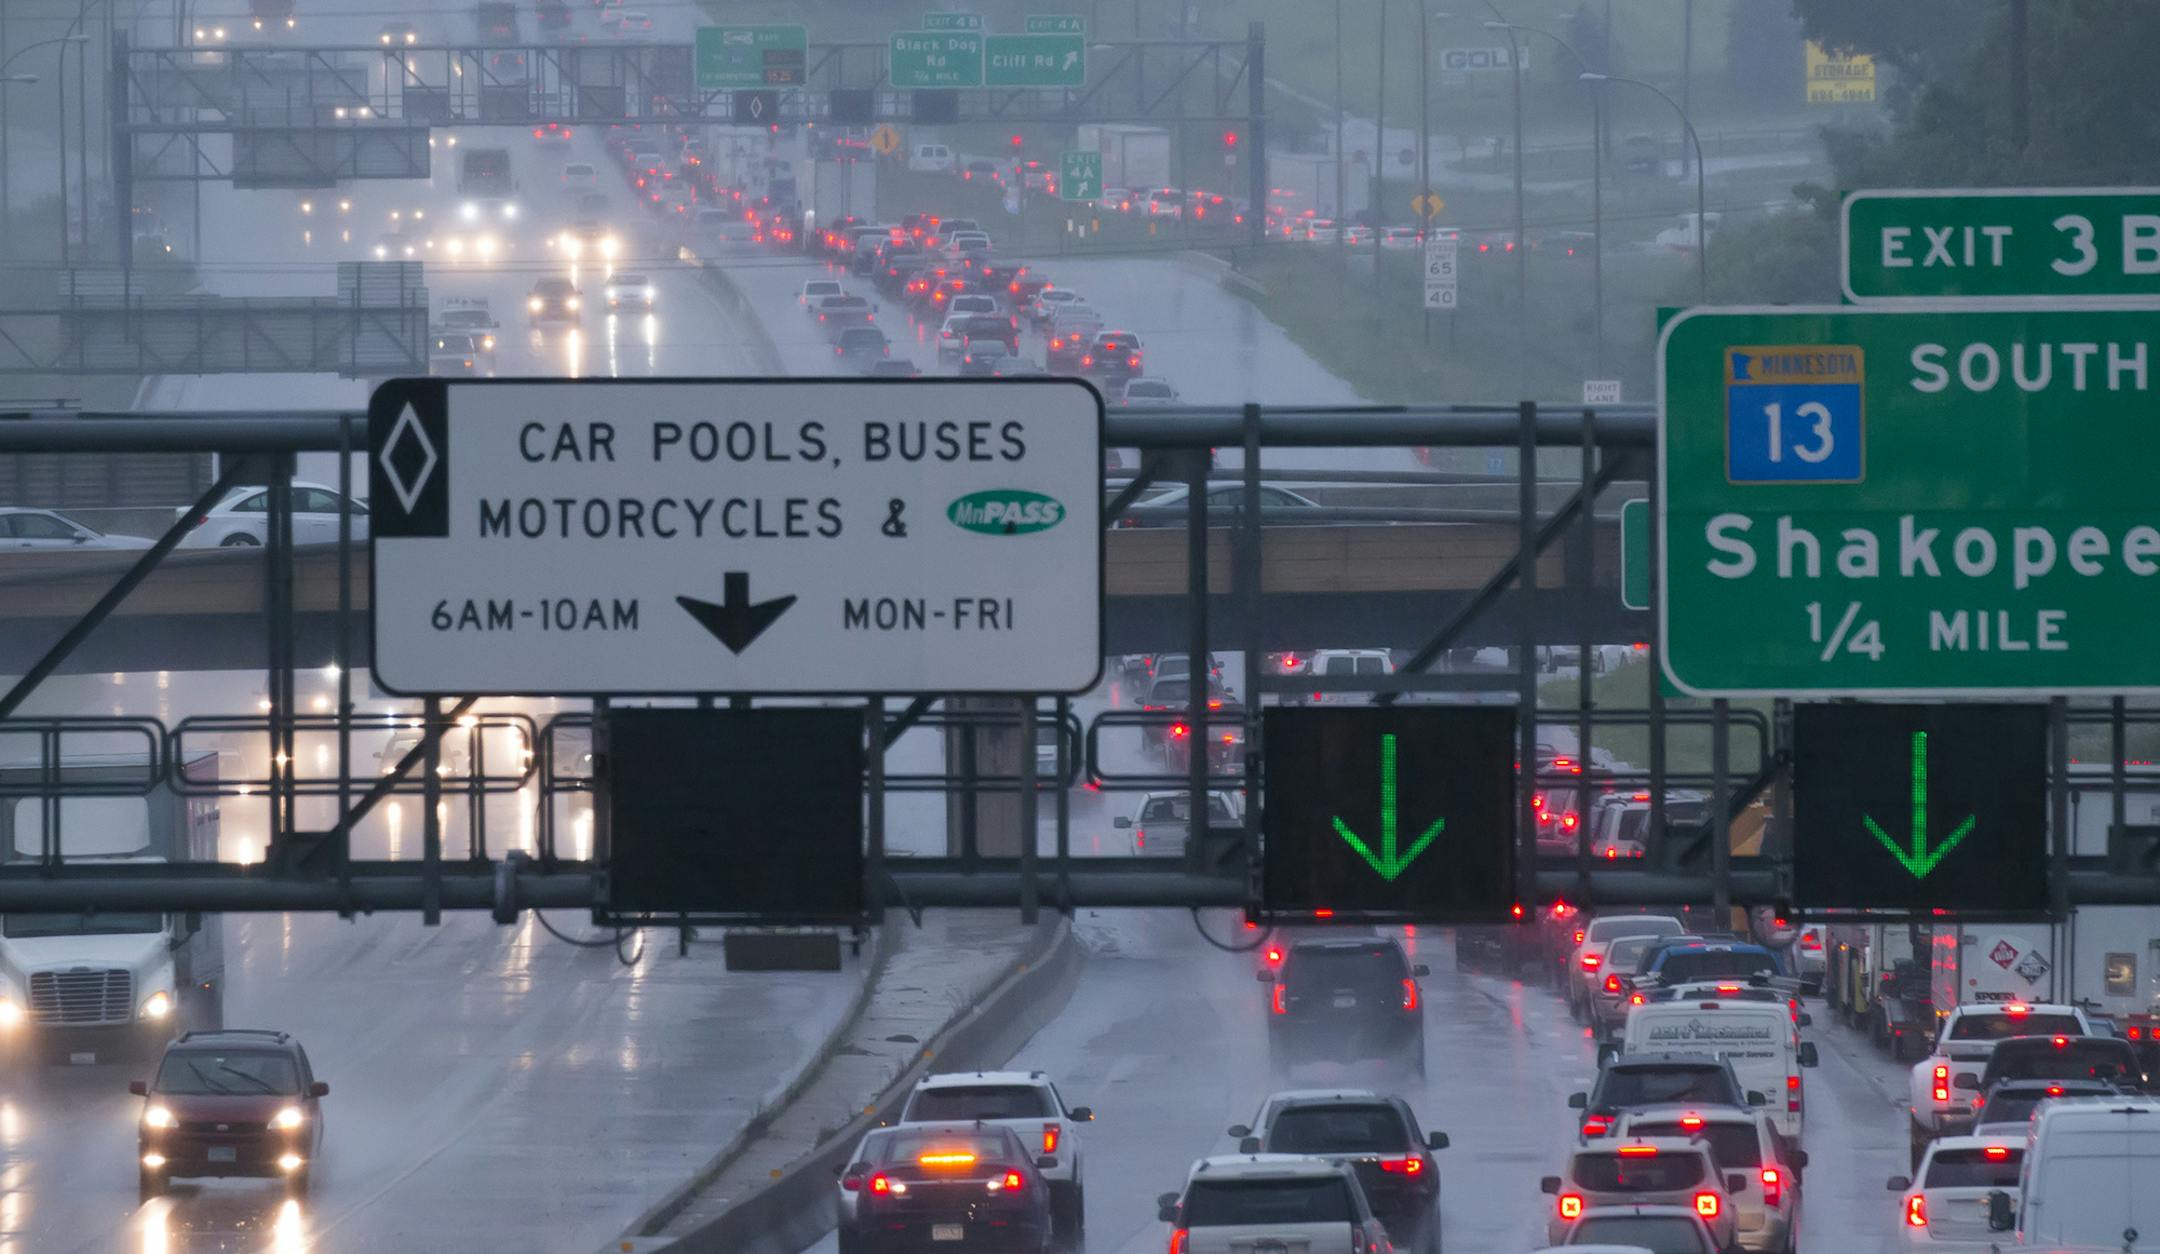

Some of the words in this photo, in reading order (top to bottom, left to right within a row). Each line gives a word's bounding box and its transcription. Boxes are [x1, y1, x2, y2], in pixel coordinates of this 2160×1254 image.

[896, 38, 941, 50] Black
[949, 38, 977, 53] Dog
[927, 55, 946, 67] Rd
[992, 54, 1026, 68] Cliff
[1034, 54, 1054, 67] Rd
[1815, 63, 1870, 76] STORAGE
[1067, 154, 1096, 164] EXIT
[1881, 225, 2013, 268] EXIT
[1430, 262, 1452, 275] 65
[1430, 291, 1453, 304] 40
[1761, 353, 1858, 375] MINNESOTA
[1910, 342, 2148, 393] SOUTH
[1587, 384, 1617, 392] RIGHT
[519, 422, 615, 463] CAR
[653, 421, 841, 468] POOLS,
[864, 420, 1027, 462] BUSES
[1763, 401, 1834, 463] 13
[479, 497, 843, 539] MOTORCYCLES
[880, 497, 908, 538] &
[955, 501, 1060, 525] MnPASS
[1704, 513, 2160, 590] Shakopee
[431, 598, 639, 632] 6AM-10AM
[843, 597, 1013, 631] MON-FRI
[1929, 609, 2069, 651] MILE
